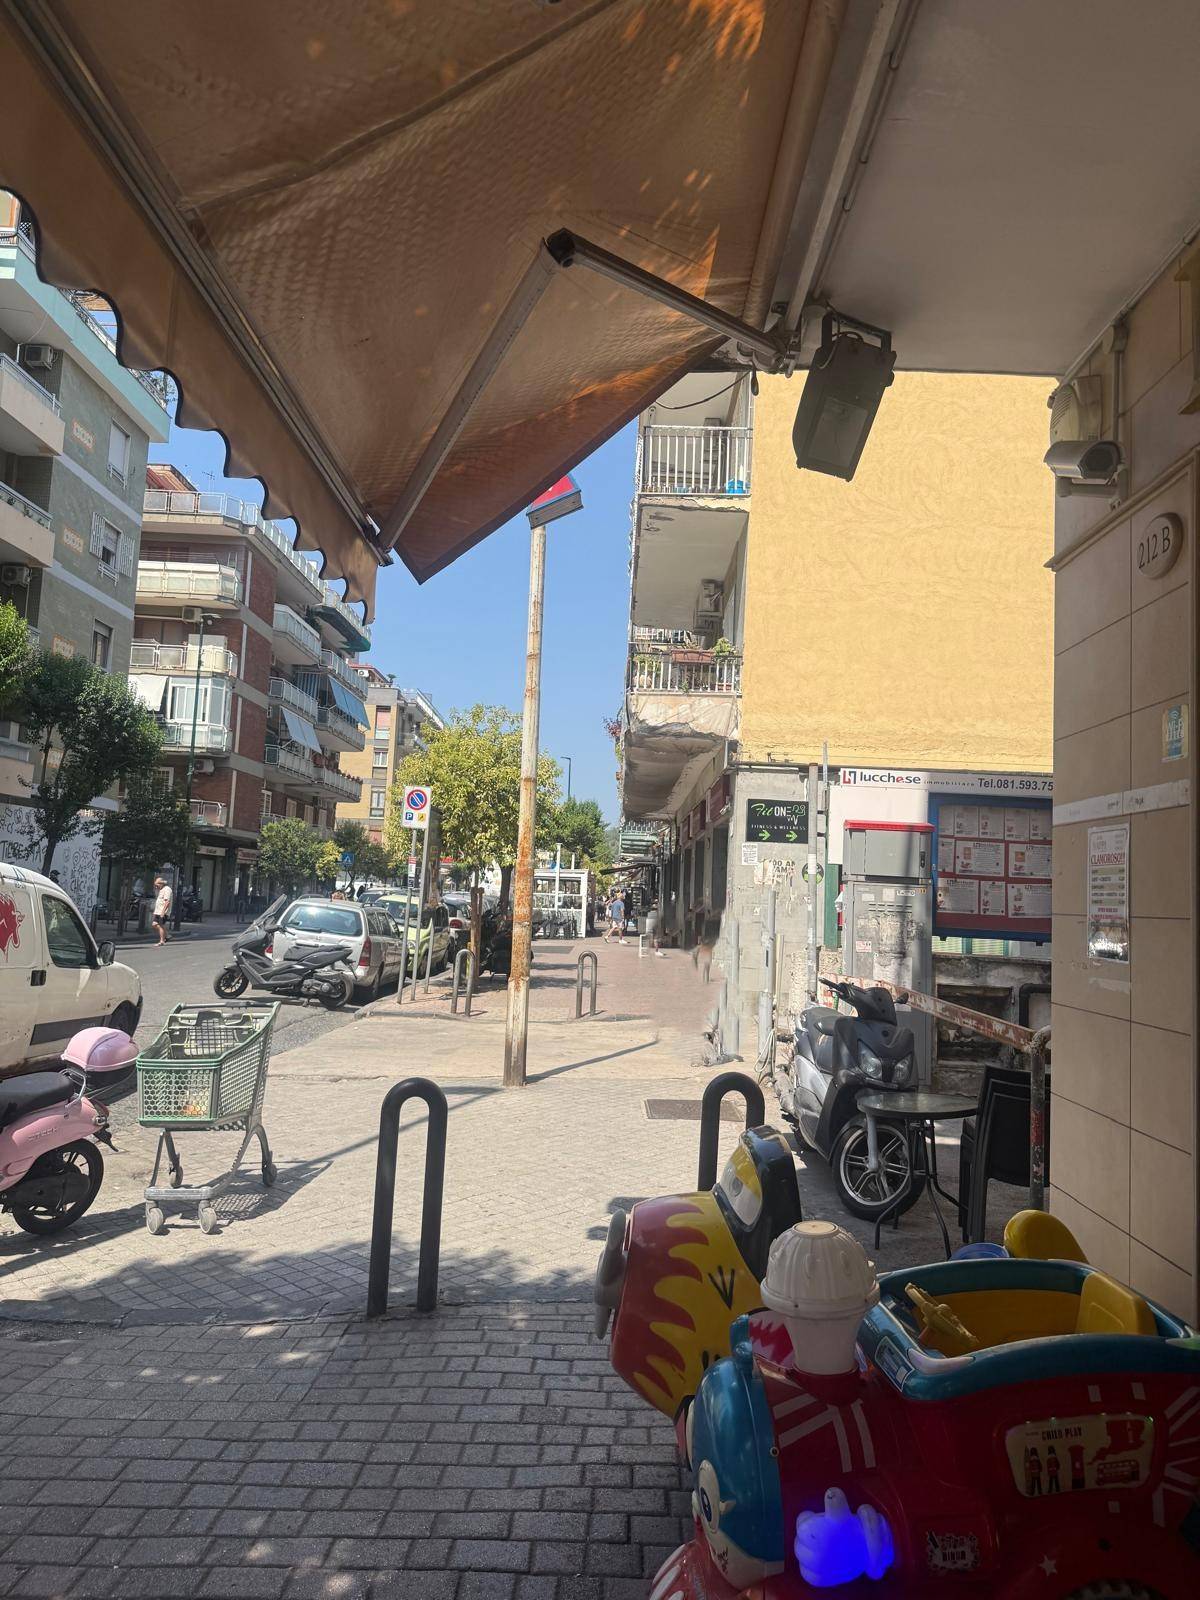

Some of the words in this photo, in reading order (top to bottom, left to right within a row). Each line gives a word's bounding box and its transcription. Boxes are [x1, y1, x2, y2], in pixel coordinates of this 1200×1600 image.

[1138, 533, 1158, 569] 212
[1162, 526, 1171, 553] B
[860, 771, 921, 785] lucchese
[977, 777, 1054, 791] Tel.081.593.75
